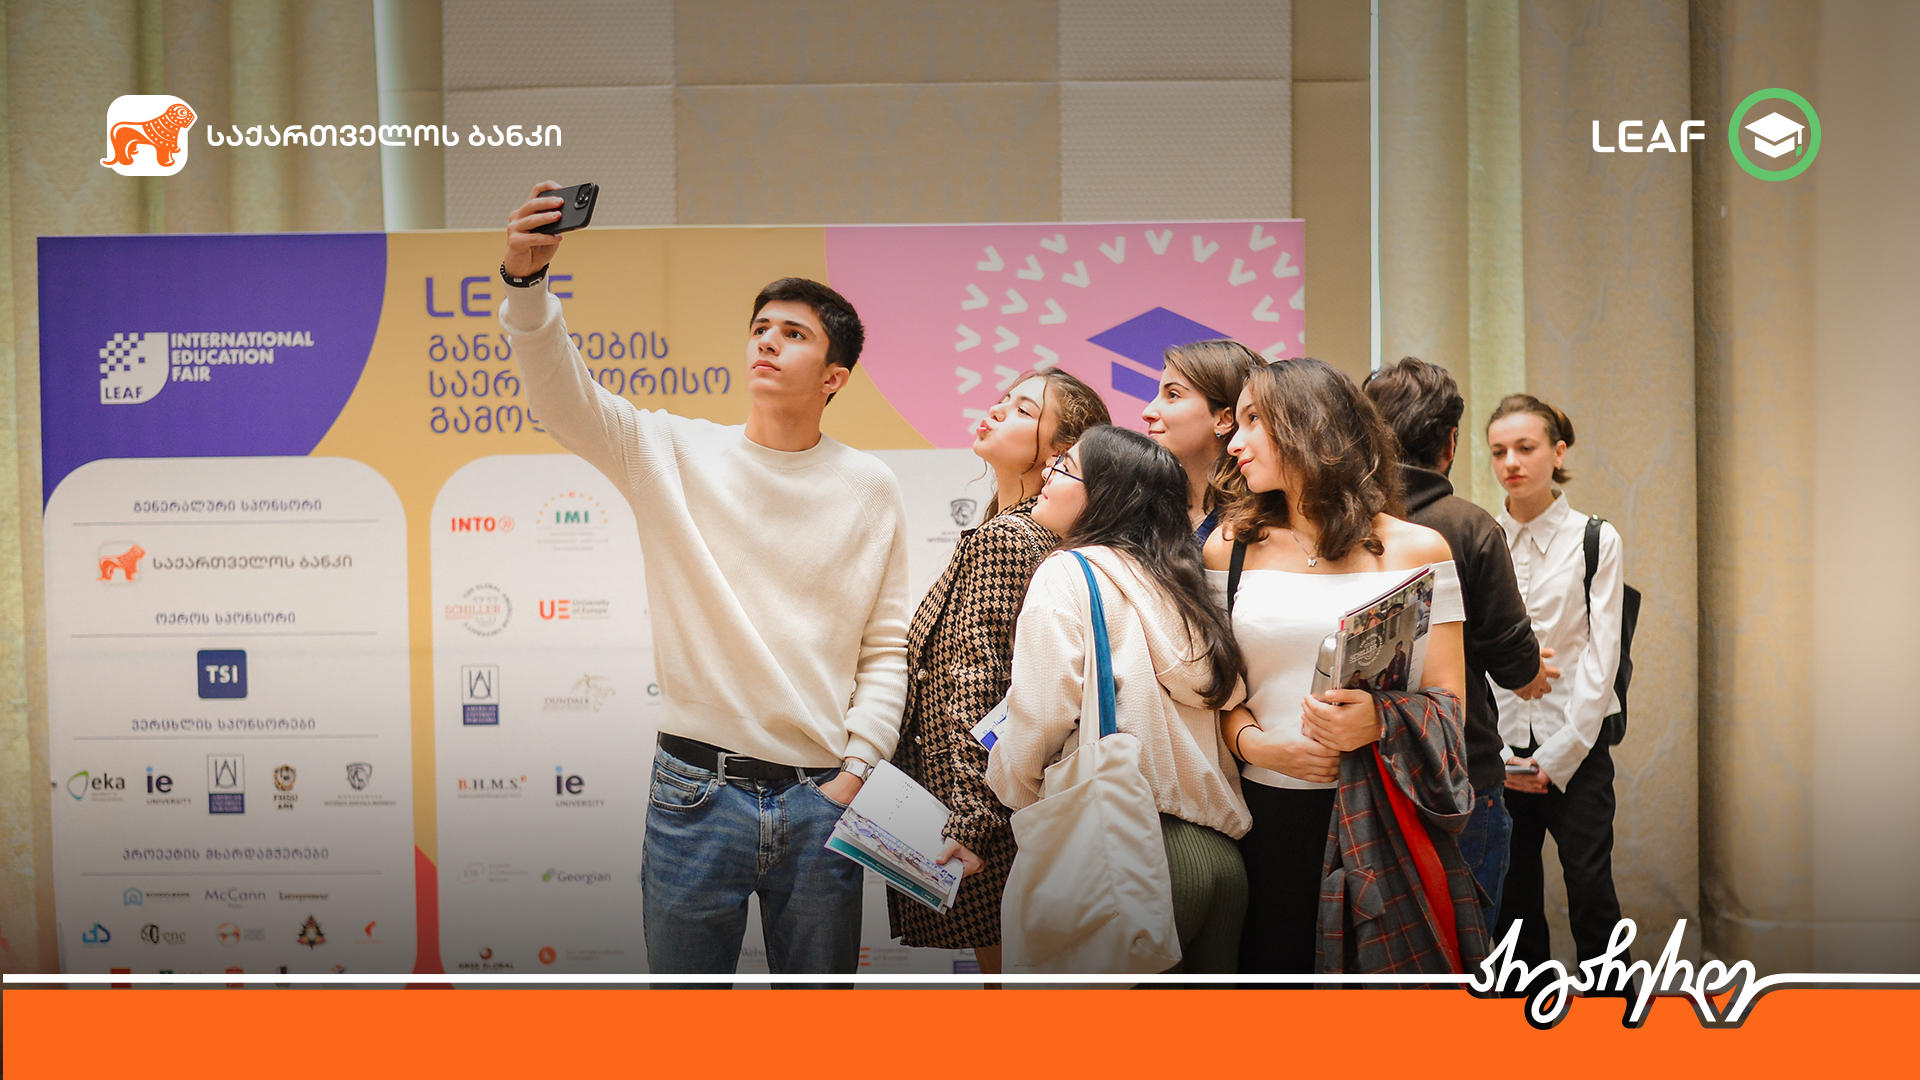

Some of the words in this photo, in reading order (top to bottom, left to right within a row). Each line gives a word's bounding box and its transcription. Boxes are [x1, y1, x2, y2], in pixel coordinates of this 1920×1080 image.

[425, 274, 574, 318] LEF
[171, 331, 315, 348] INTERNATIONAL
[429, 331, 670, 362] განაების
[171, 349, 275, 366] EDUCATION
[171, 366, 212, 382] FAIR
[429, 366, 731, 398] საერორისო
[105, 386, 143, 401] LEAF
[133, 500, 236, 514] გენერალური
[241, 499, 322, 513] სპონსორი
[451, 516, 496, 533] INTO
[555, 510, 590, 524] IMI
[152, 555, 296, 571] საქართველოს
[300, 555, 353, 570] ბანკი
[155, 612, 210, 626] ოქროს
[215, 611, 296, 625] სპონსორი
[539, 599, 571, 621] UE
[205, 664, 239, 684] TSI
[91, 772, 126, 791] eka
[146, 766, 174, 794] ie
[555, 765, 585, 796] ie
[555, 800, 605, 808] UNIVERSITY
[557, 871, 612, 885] Georgian
[204, 887, 266, 902] McCann
